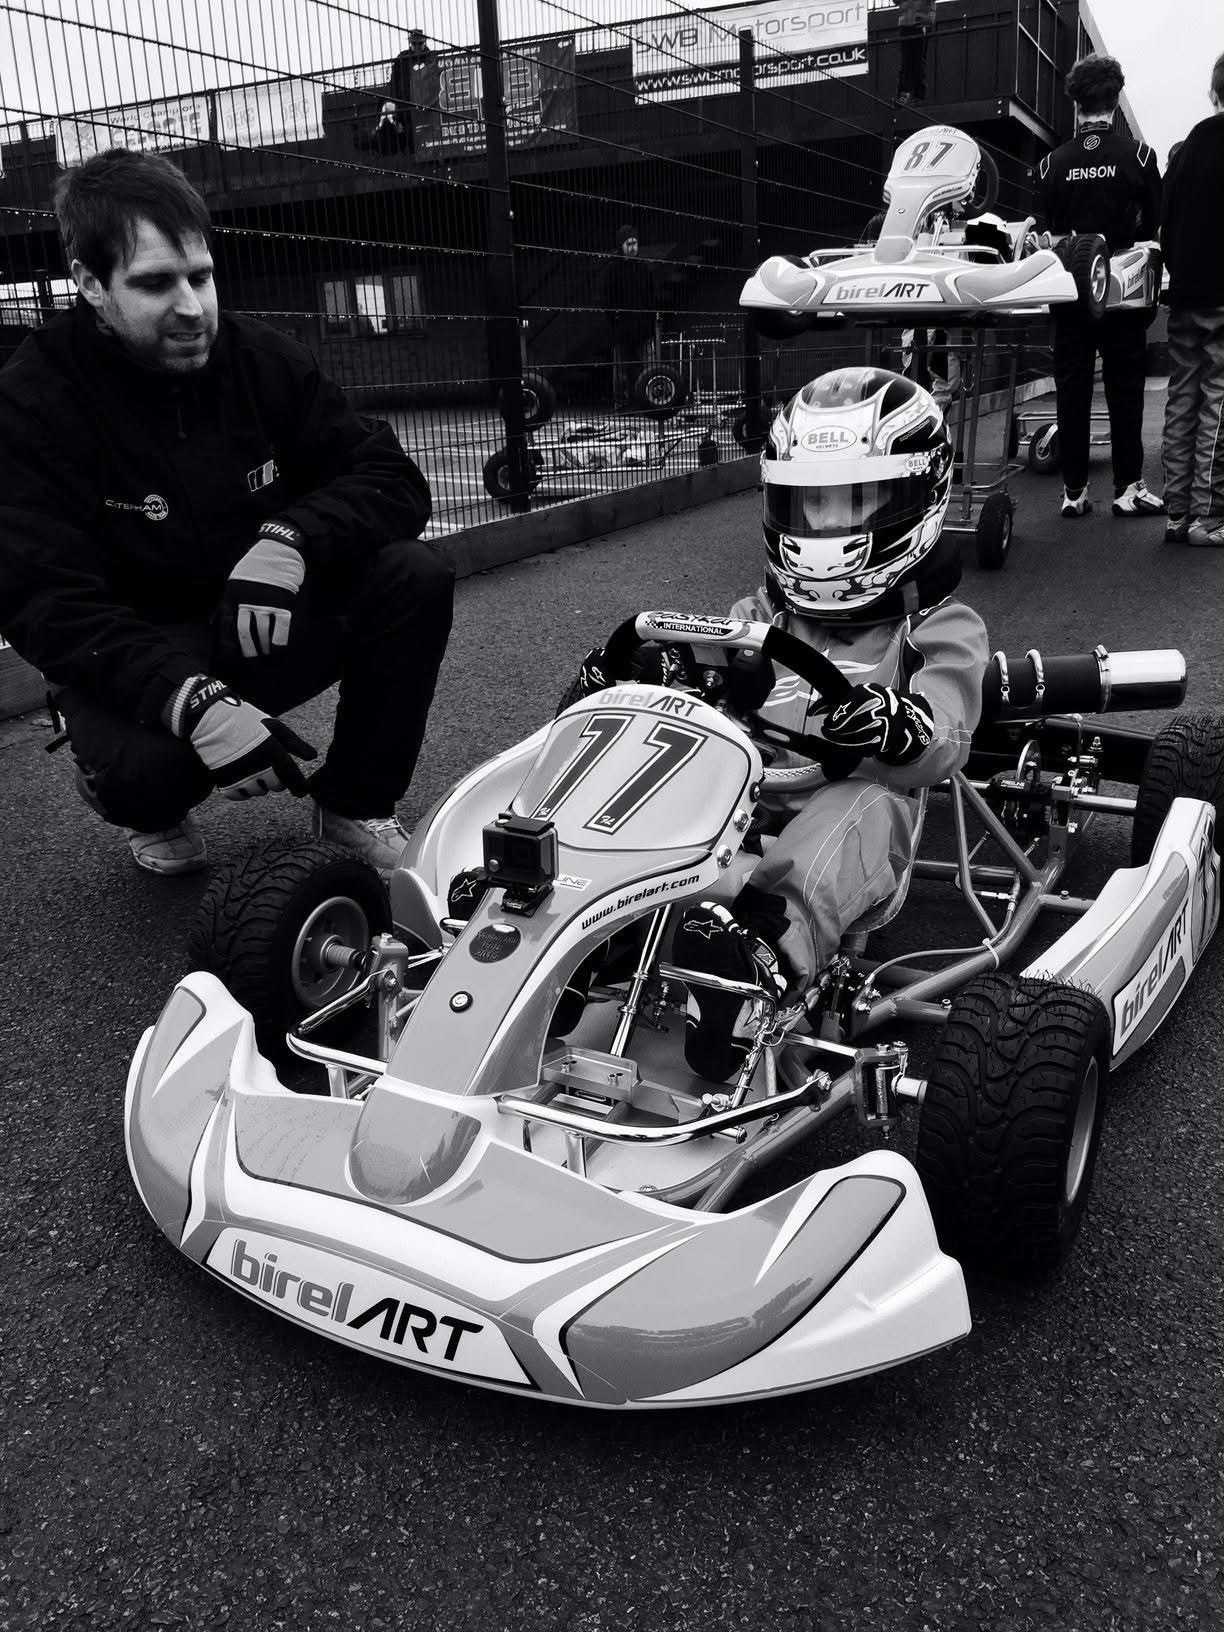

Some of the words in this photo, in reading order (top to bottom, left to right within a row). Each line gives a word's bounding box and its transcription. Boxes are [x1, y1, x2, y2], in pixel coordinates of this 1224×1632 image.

[709, 3, 864, 43] Mtorsport
[1066, 164, 1116, 181] JENSON
[837, 282, 930, 300] birelART
[807, 431, 849, 445] BELL
[908, 459, 926, 468] BELL
[259, 523, 295, 541] STIHL
[663, 621, 725, 636] INTERNATIONAL
[190, 679, 228, 709] STIHL
[600, 688, 703, 717] birelART
[582, 874, 700, 930] www.birelart.com
[1120, 898, 1188, 1037] birelART
[231, 1238, 484, 1362] birelART
